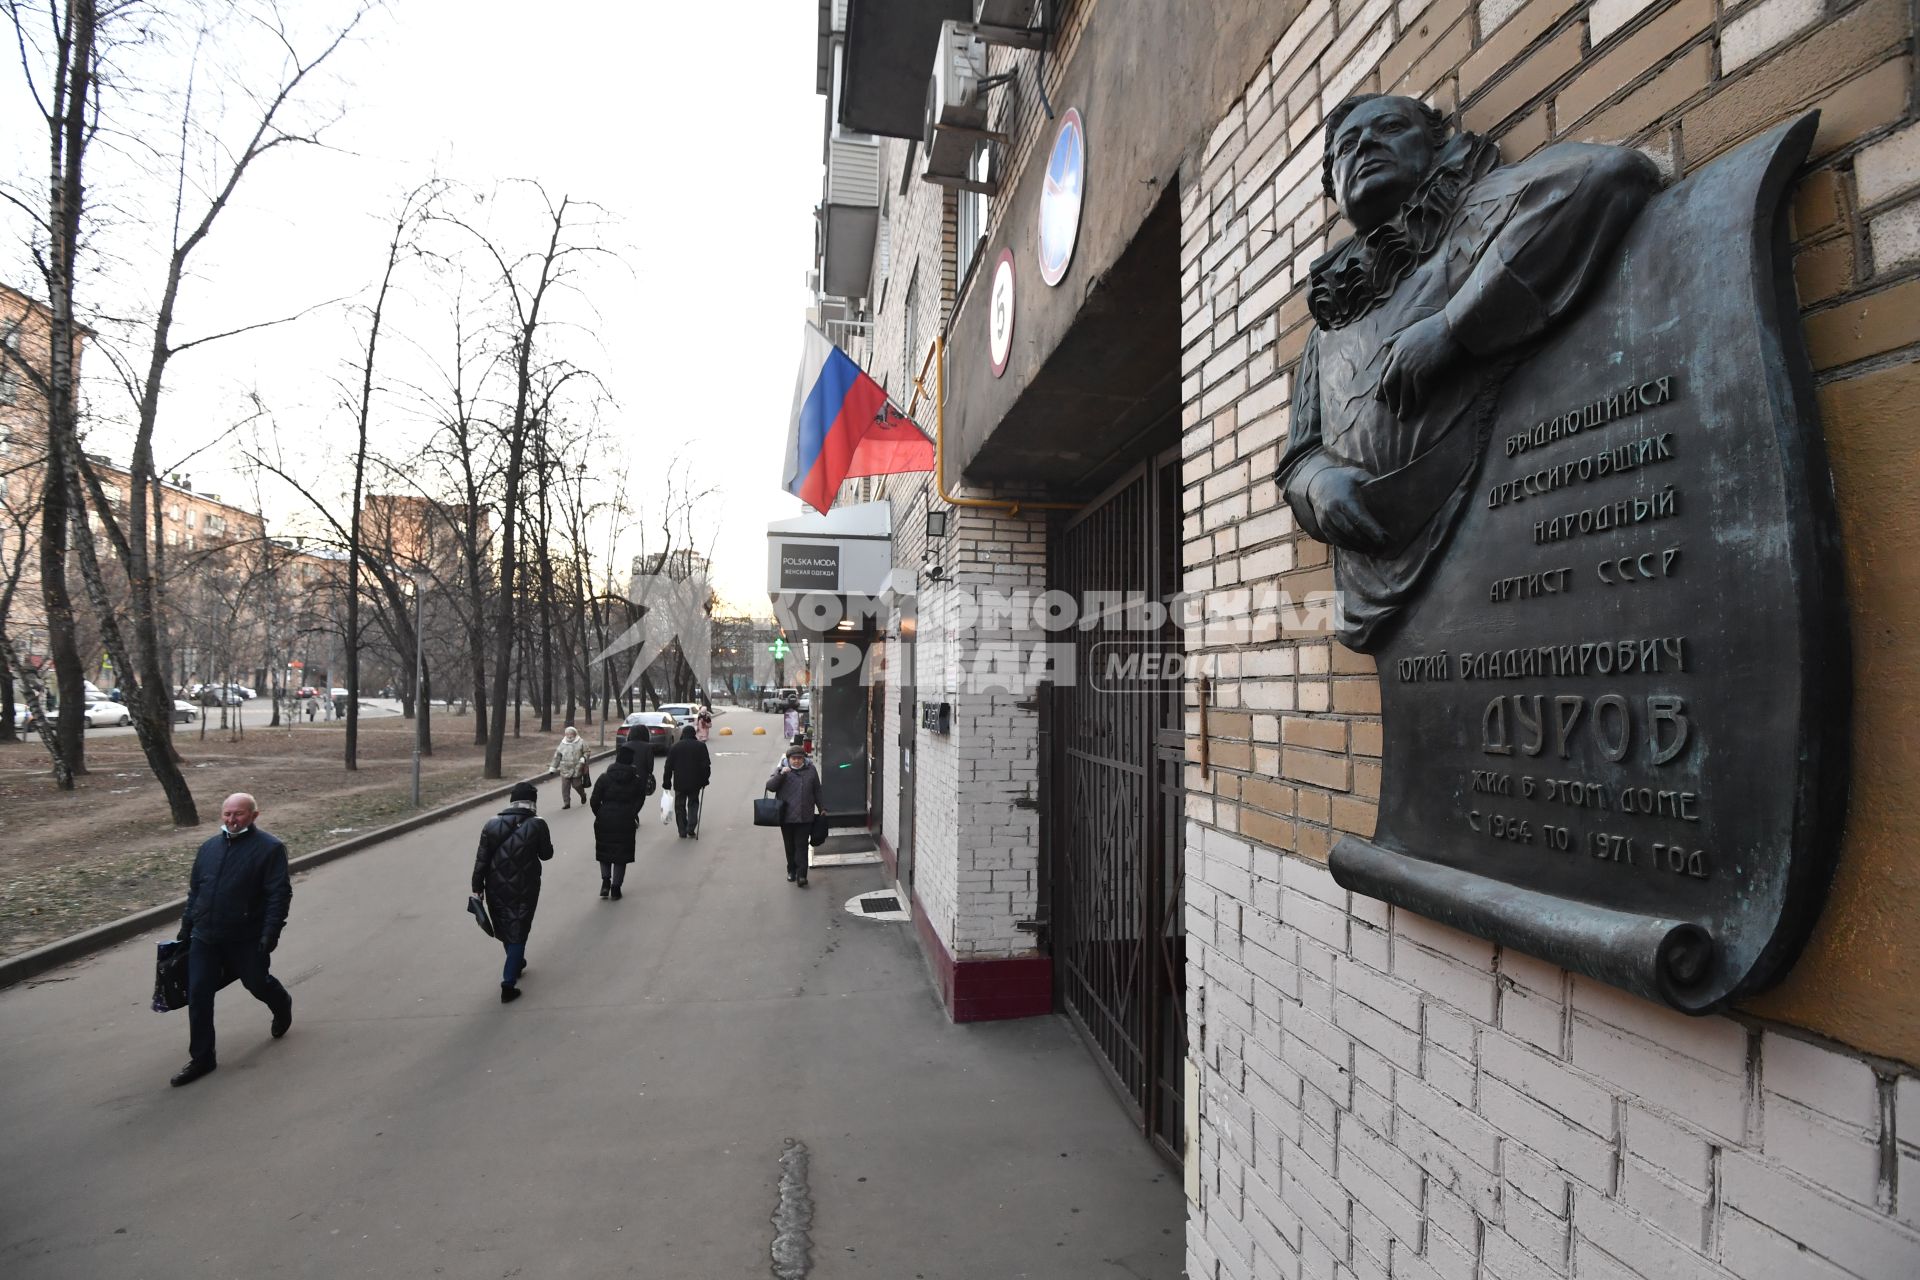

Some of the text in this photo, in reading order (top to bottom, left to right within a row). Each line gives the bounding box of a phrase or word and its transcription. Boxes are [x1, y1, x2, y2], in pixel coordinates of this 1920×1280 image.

[1505, 375, 1673, 457] ВЫДАЮЩИЙСЯ
[1487, 432, 1673, 508] ДРЕССИРОВЩИК
[1533, 484, 1676, 544] НАРОДНЫЙ
[783, 557, 837, 567] POLSKA MODA
[1489, 547, 1681, 602] АРТИСТ СССР
[1398, 636, 1685, 682] ЮРИЙ ВЛАДИМИРОВИЧ
[1482, 693, 1690, 766] ДУРОВ
[1471, 769, 1700, 822] ЖИЛ В ЭТОМ ДОМЕ
[1468, 810, 1709, 879] С 1964 ПО 1971 ГОД
